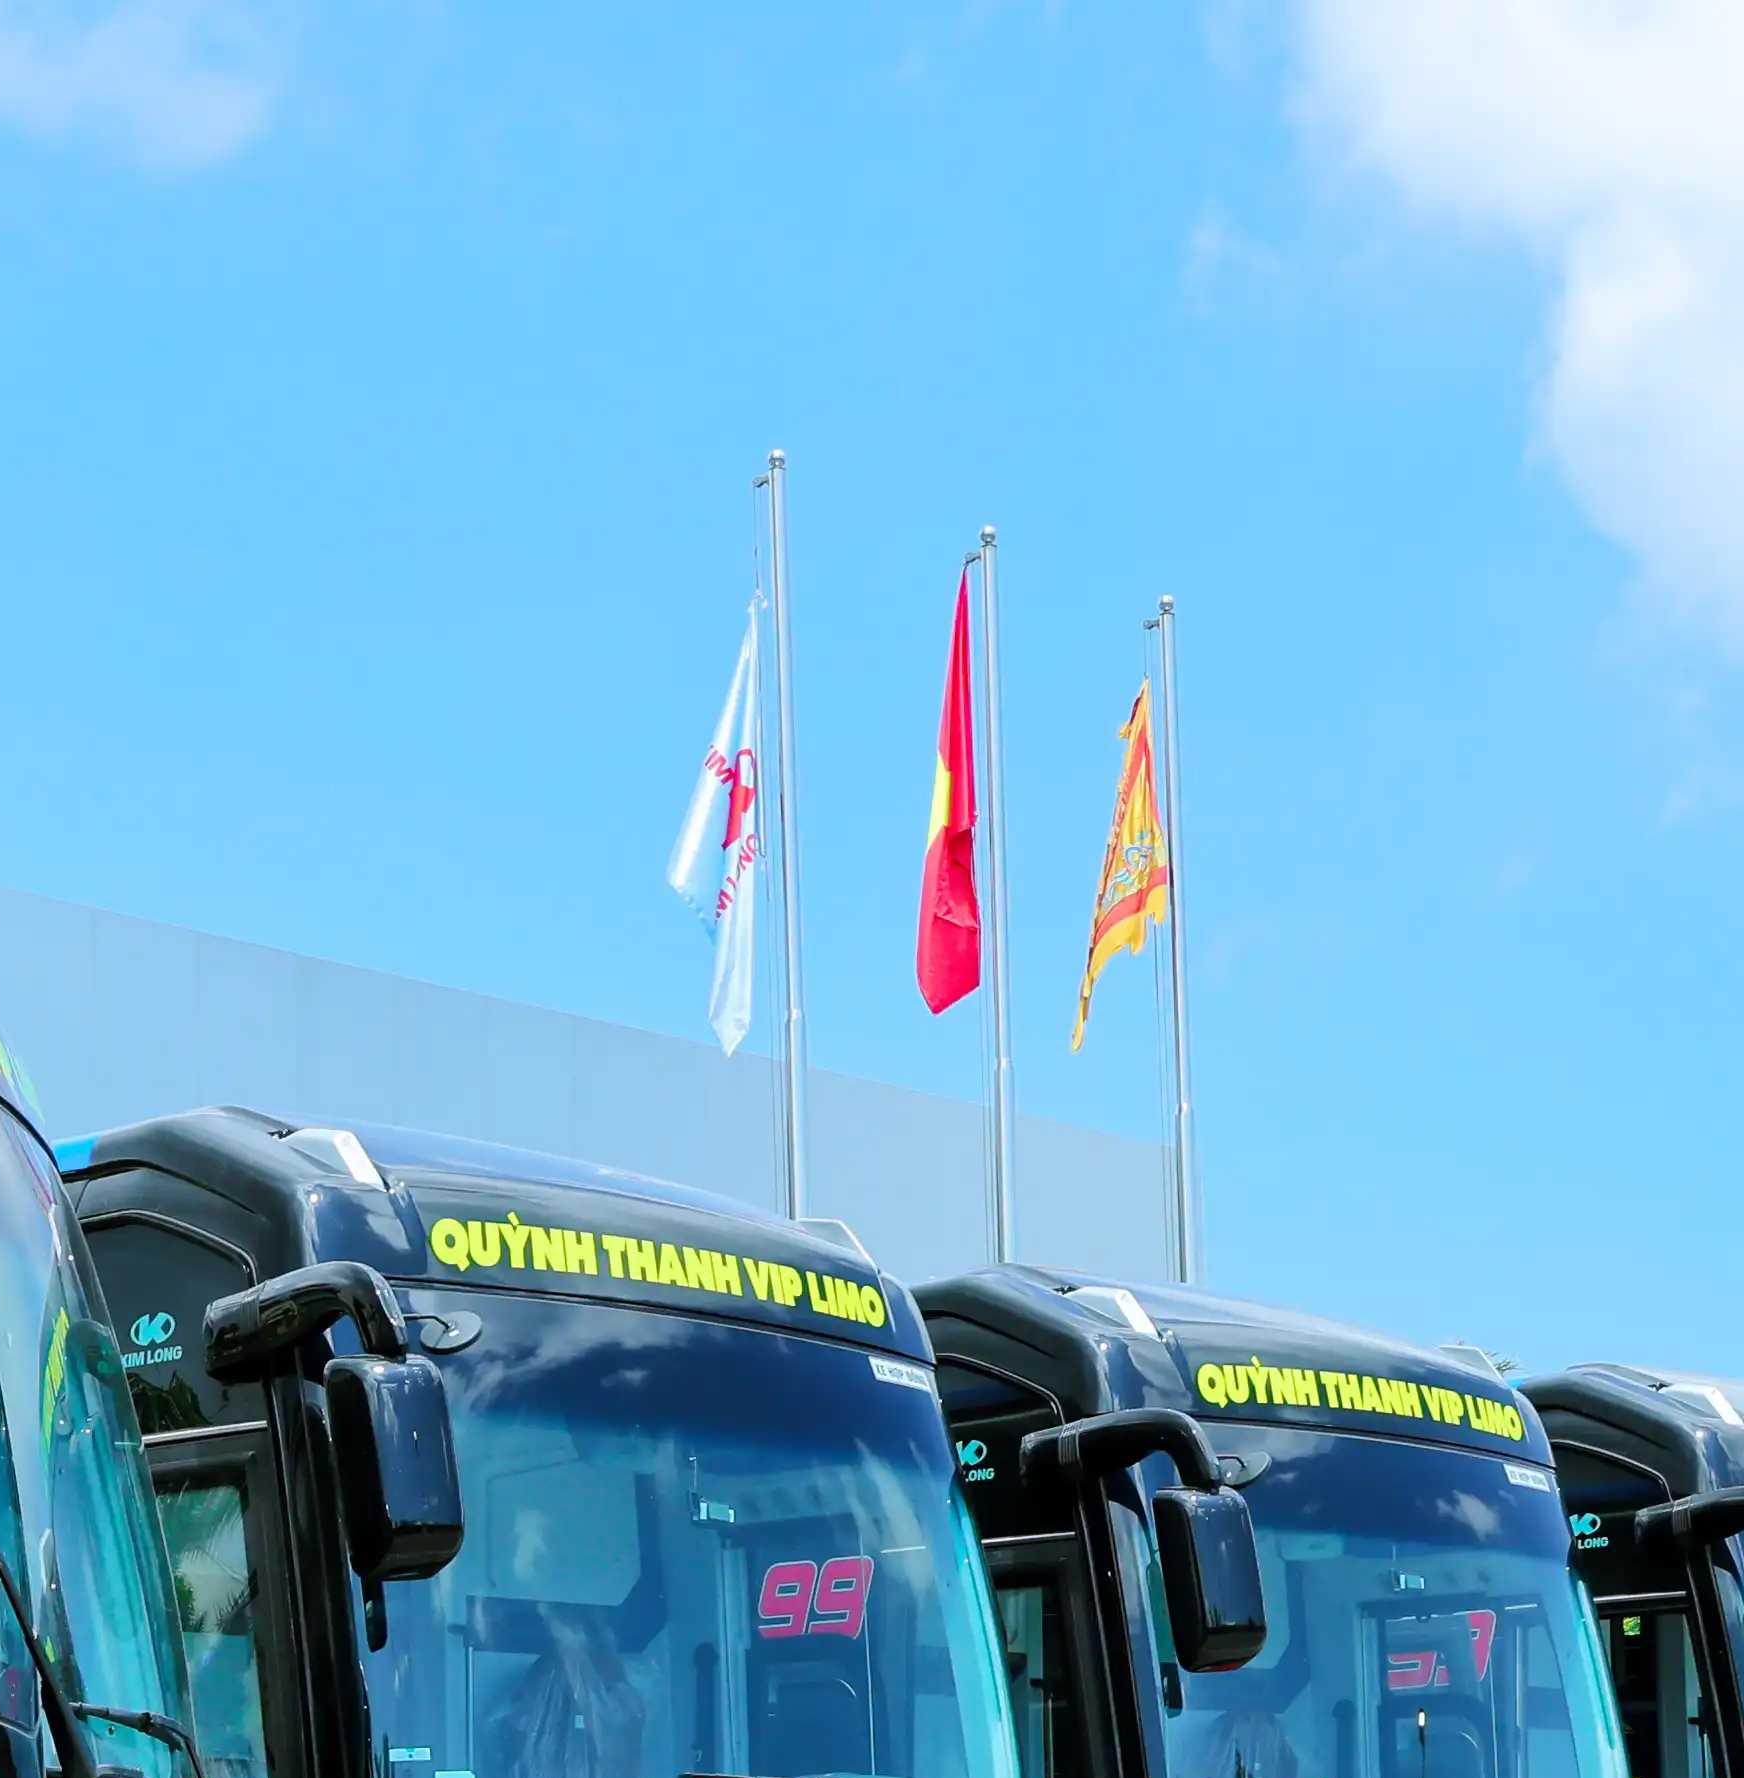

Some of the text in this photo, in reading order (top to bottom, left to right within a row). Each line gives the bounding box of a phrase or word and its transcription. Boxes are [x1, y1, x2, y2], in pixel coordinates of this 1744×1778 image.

[430, 1212, 886, 1328] QUỲNH THANH VIP LIMO
[147, 1345, 183, 1365] LONG
[1197, 1356, 1524, 1442] QUỲNH THANH VIP LIMO
[964, 1467, 995, 1483] ONG
[1577, 1536, 1609, 1550] LONG
[758, 1555, 874, 1640] 99
